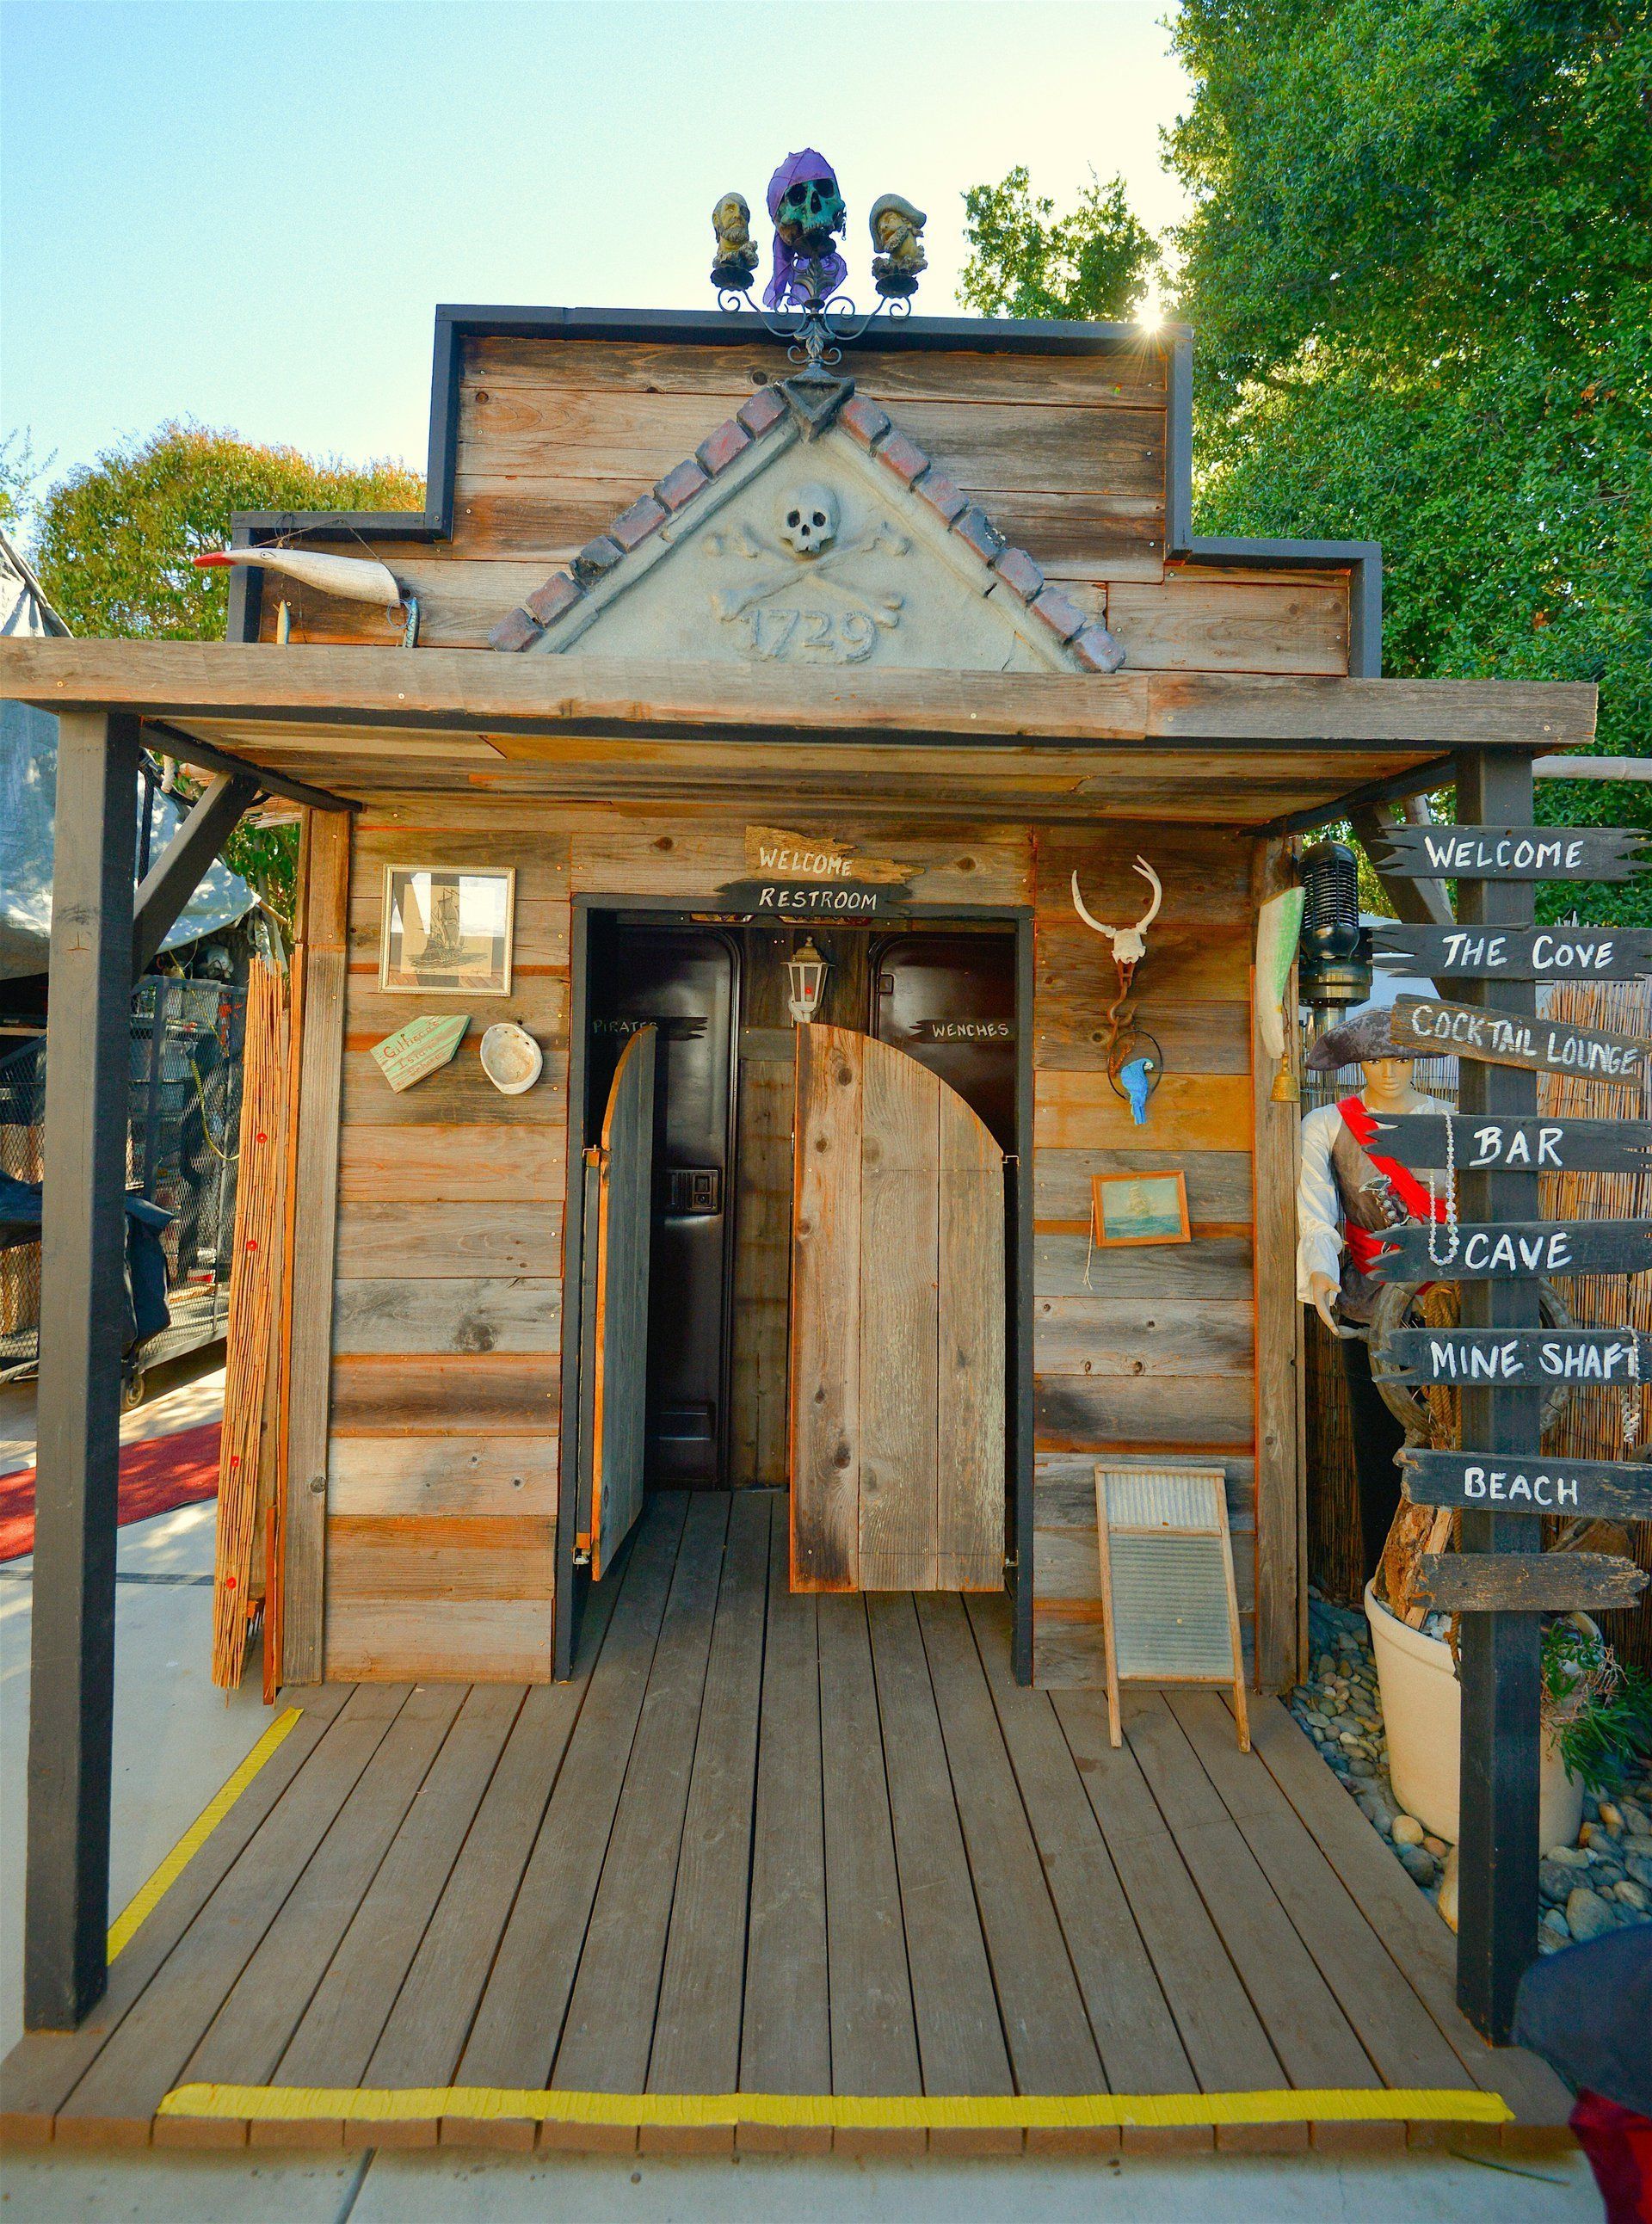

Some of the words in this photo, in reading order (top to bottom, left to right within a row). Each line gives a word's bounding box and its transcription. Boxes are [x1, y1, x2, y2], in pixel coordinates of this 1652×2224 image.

[740, 609, 877, 659] 1729
[759, 847, 854, 877] WELCOME
[1424, 836, 1584, 869] WELCOME
[759, 887, 877, 910] RESTROOM
[1442, 933, 1508, 968] THE
[1532, 935, 1613, 969] COVE
[933, 1023, 1009, 1038] WENCHES
[1411, 1005, 1538, 1057] COCKTAIL
[1547, 1032, 1639, 1075] LOUNGE
[1470, 1126, 1564, 1167] BAR
[1464, 1232, 1573, 1271] CAVE
[1430, 1340, 1524, 1378] MINE
[1538, 1342, 1636, 1379] SHAFT
[1464, 1467, 1578, 1506] BEACH
